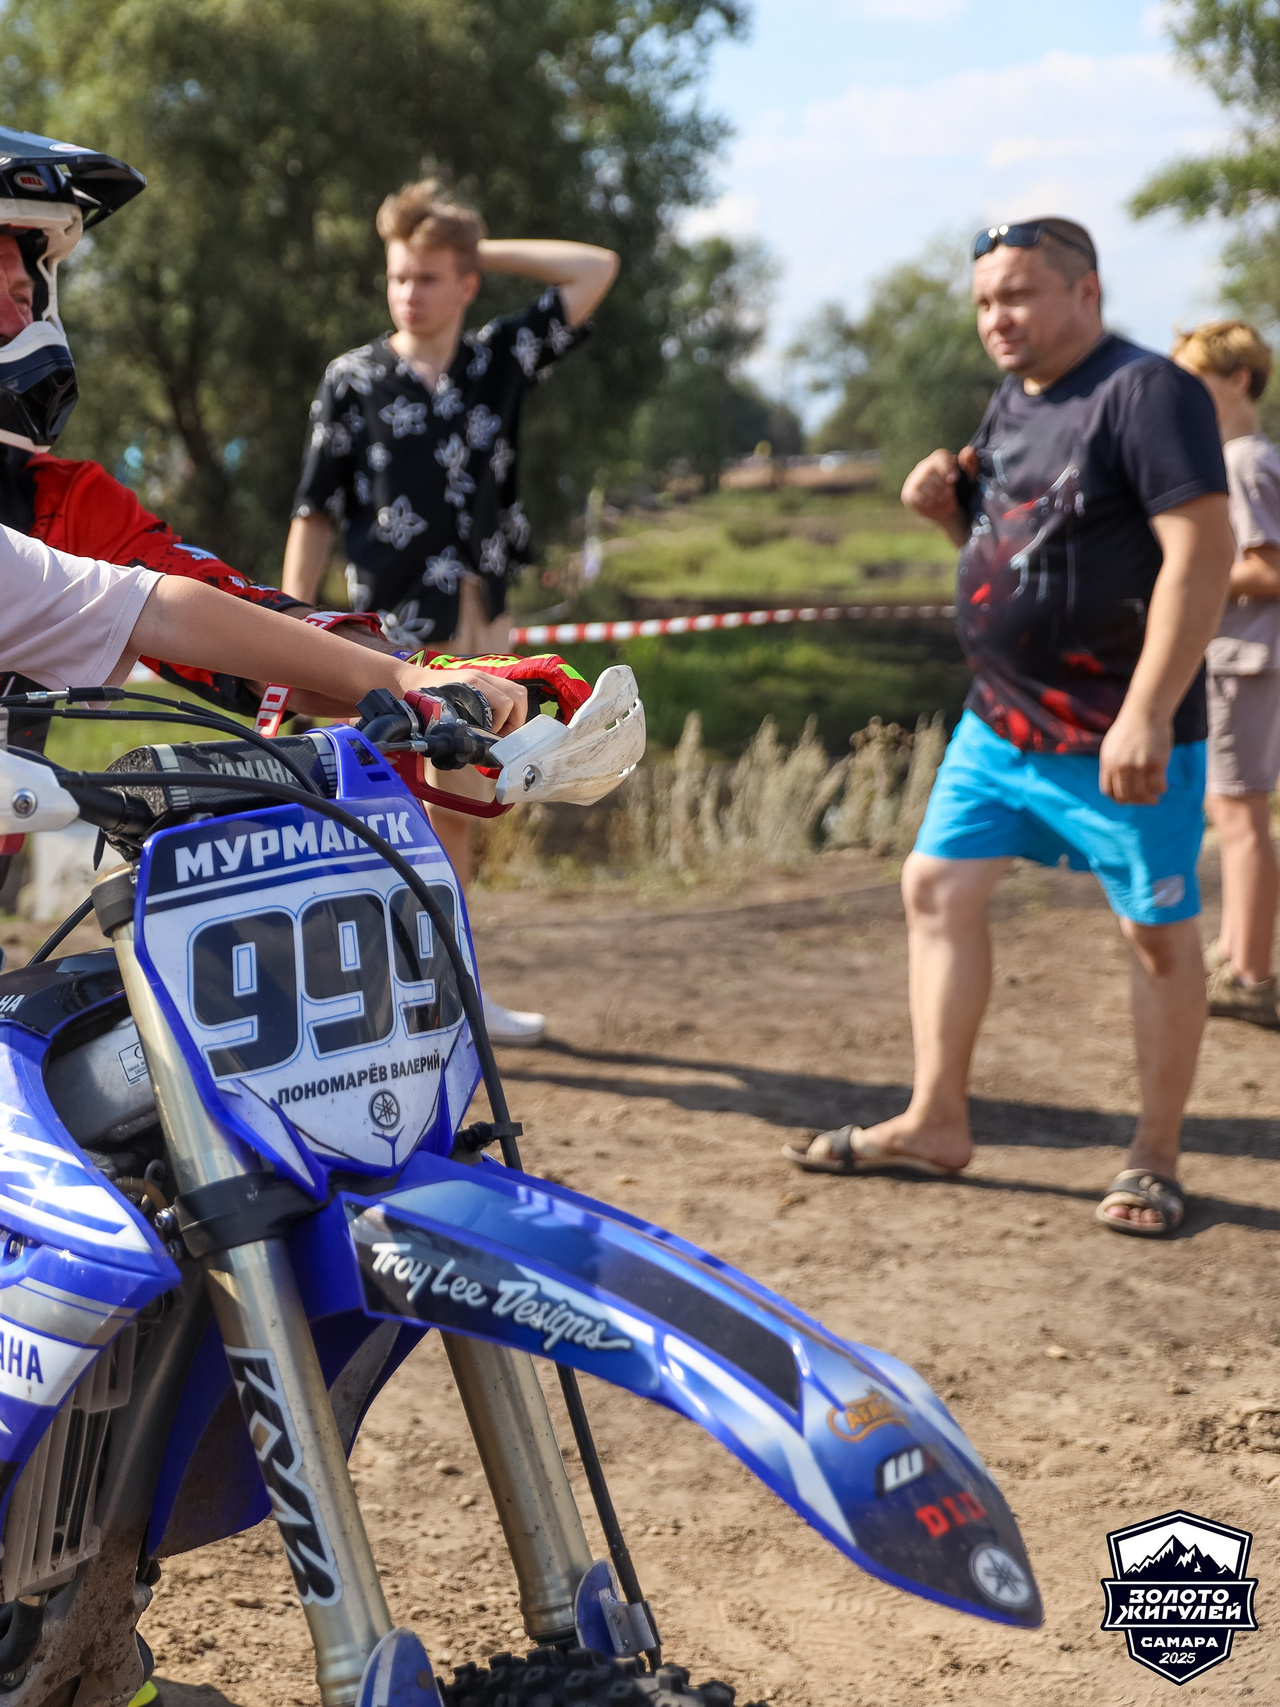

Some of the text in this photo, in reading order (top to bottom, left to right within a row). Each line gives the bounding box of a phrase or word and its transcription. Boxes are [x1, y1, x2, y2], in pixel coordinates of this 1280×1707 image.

[190, 882, 467, 1079] 999
[277, 1049, 441, 1106] ПОНОМАРЁВ ВАЛЕРИЙ
[371, 1242, 633, 1351] Troy Lee Designs
